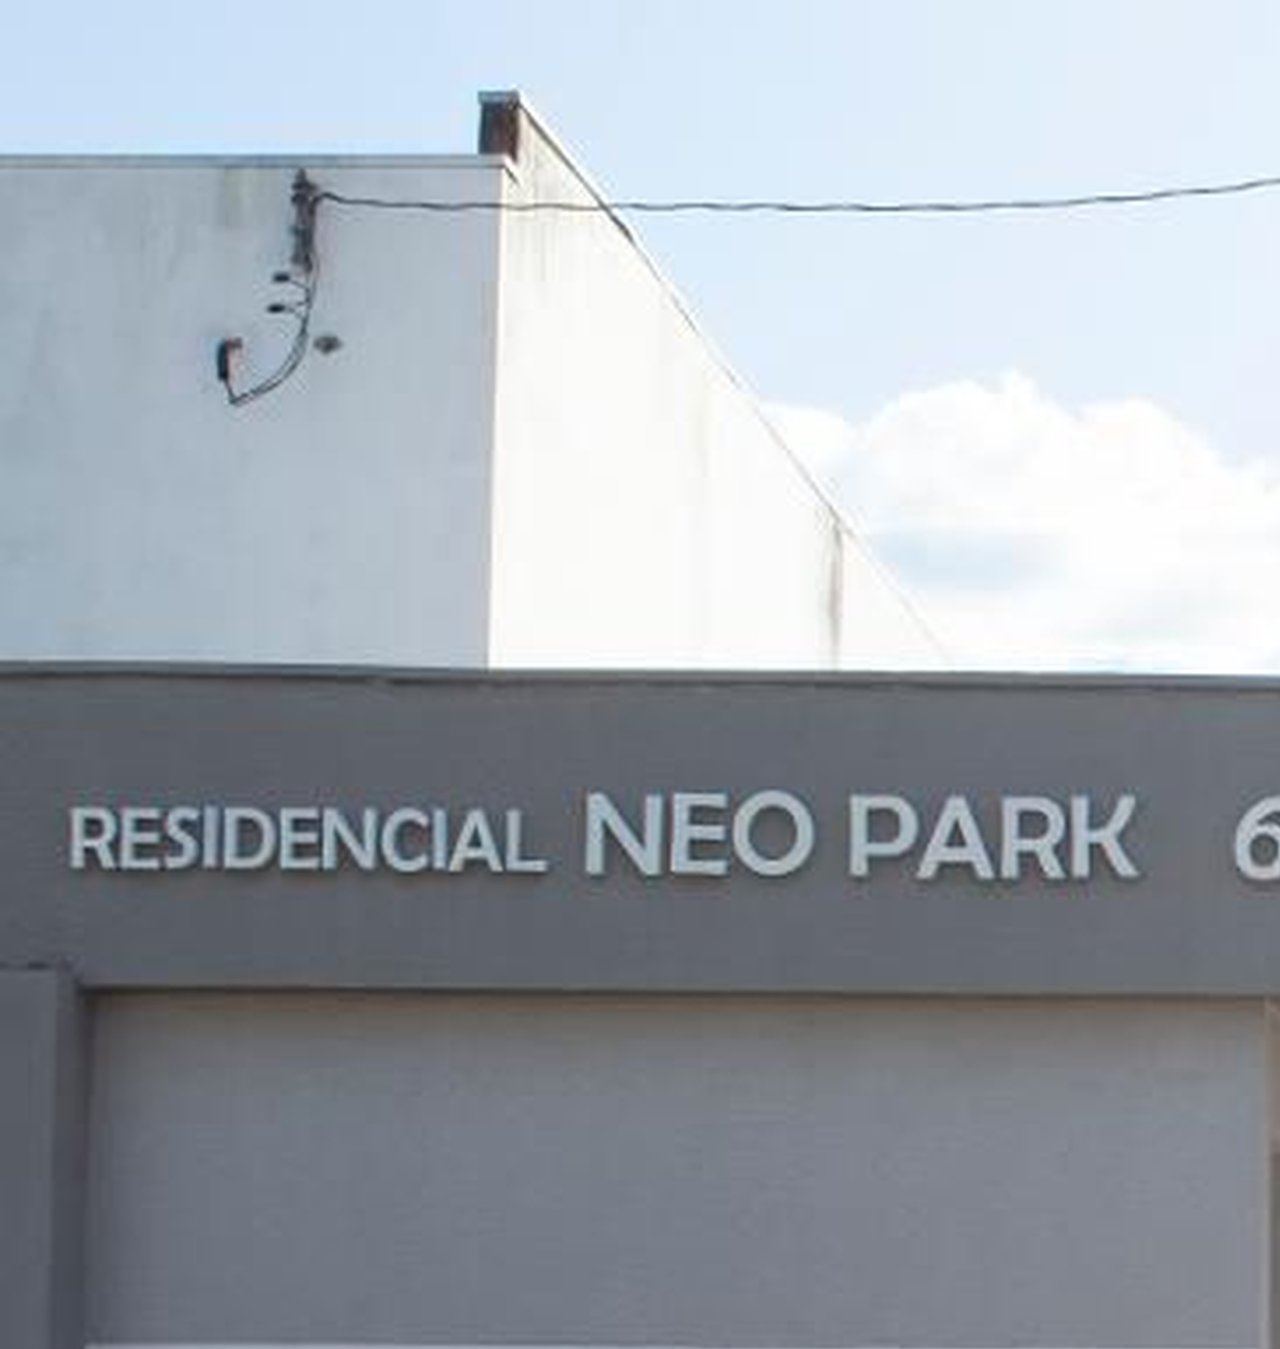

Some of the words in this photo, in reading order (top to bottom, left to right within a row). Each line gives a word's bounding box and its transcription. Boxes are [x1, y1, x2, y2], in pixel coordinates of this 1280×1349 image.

[68, 804, 548, 872] RESIDENCIAL
[583, 790, 815, 876] NEO
[848, 794, 1139, 880] PARK
